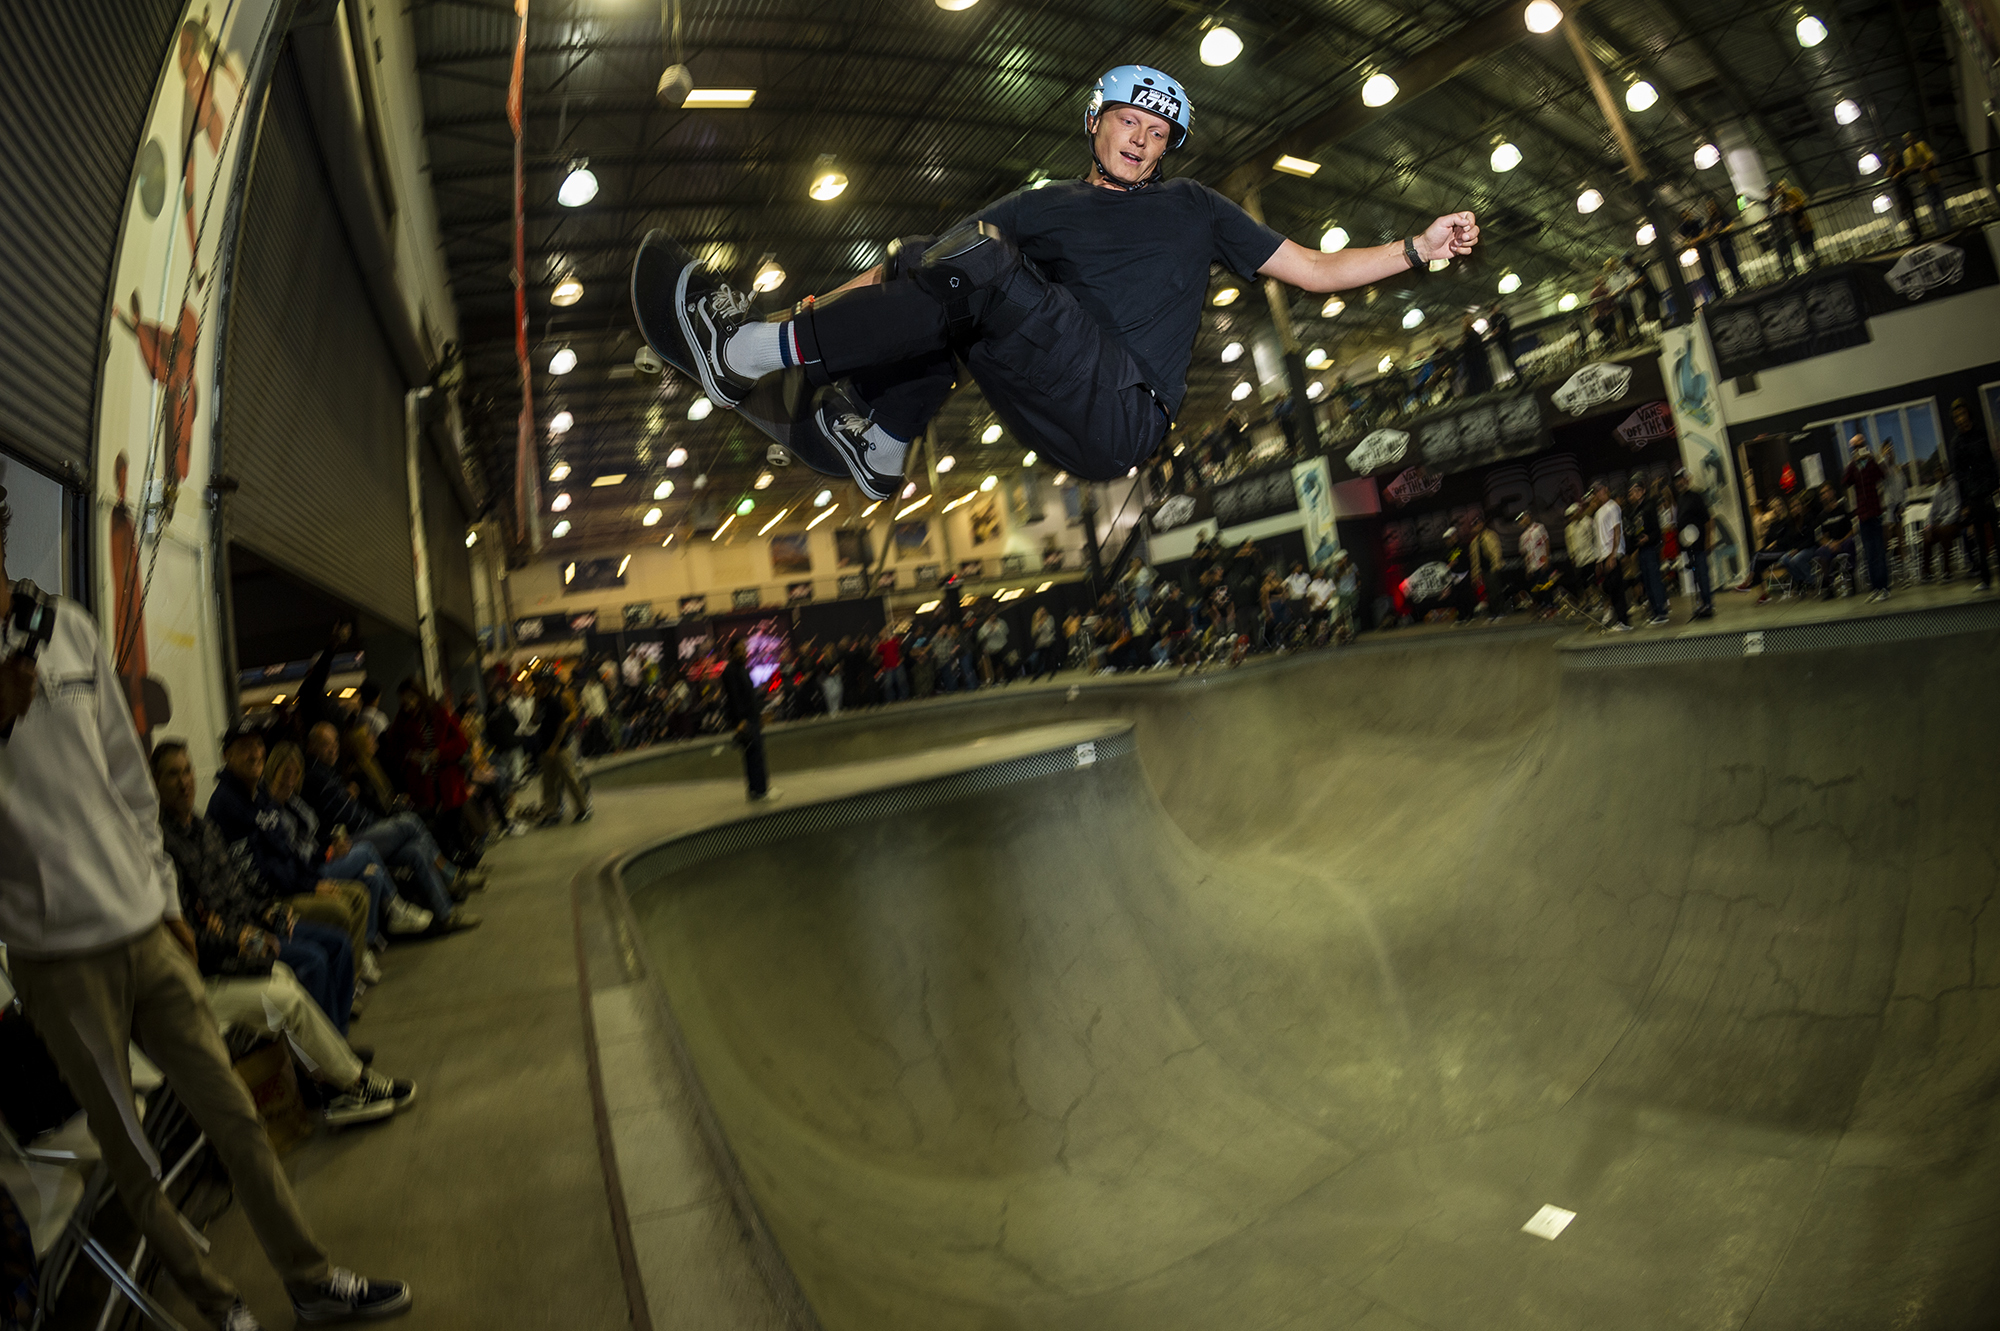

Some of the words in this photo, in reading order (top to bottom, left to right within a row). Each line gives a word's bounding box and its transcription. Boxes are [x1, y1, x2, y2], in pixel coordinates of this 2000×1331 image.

[1132, 89, 1180, 118] ムラサキ
[1636, 405, 1663, 422] VANS
[1642, 416, 1664, 435] THE
[1407, 479, 1423, 493] THE
